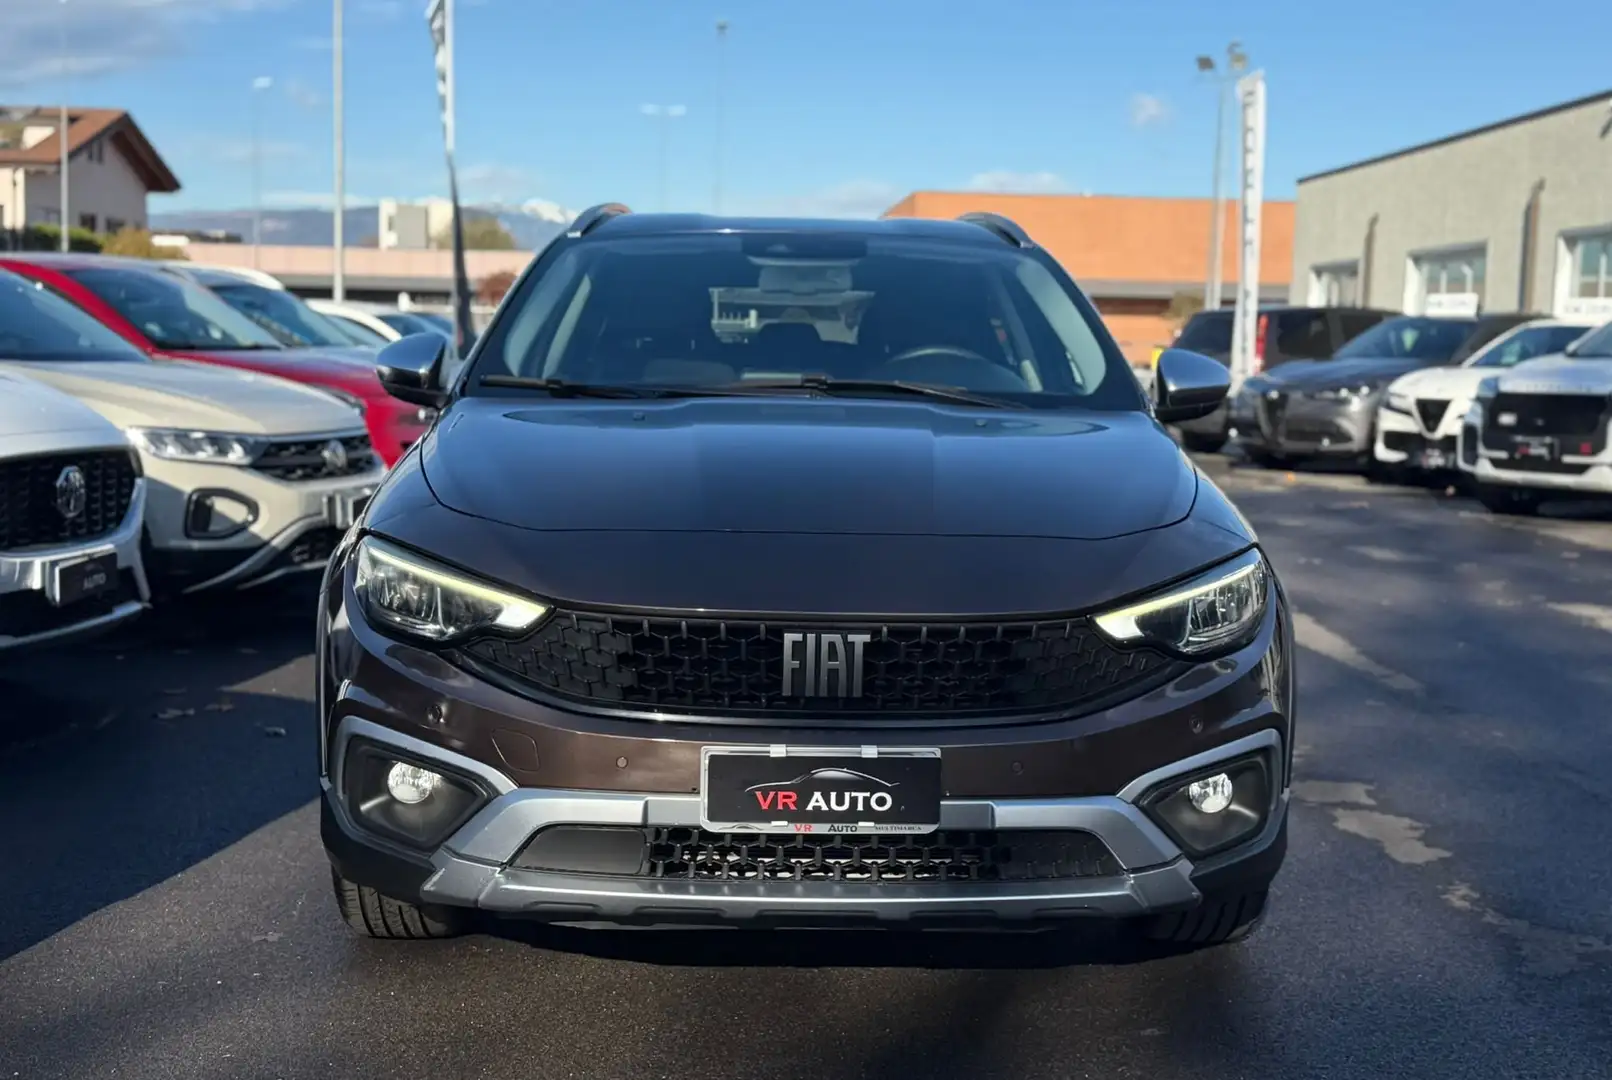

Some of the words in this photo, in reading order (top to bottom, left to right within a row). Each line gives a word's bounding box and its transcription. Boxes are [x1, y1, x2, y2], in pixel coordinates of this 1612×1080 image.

[782, 632, 871, 697] FIAT
[755, 790, 798, 811] VR
[806, 790, 893, 812] AUTO
[794, 823, 813, 833] VR
